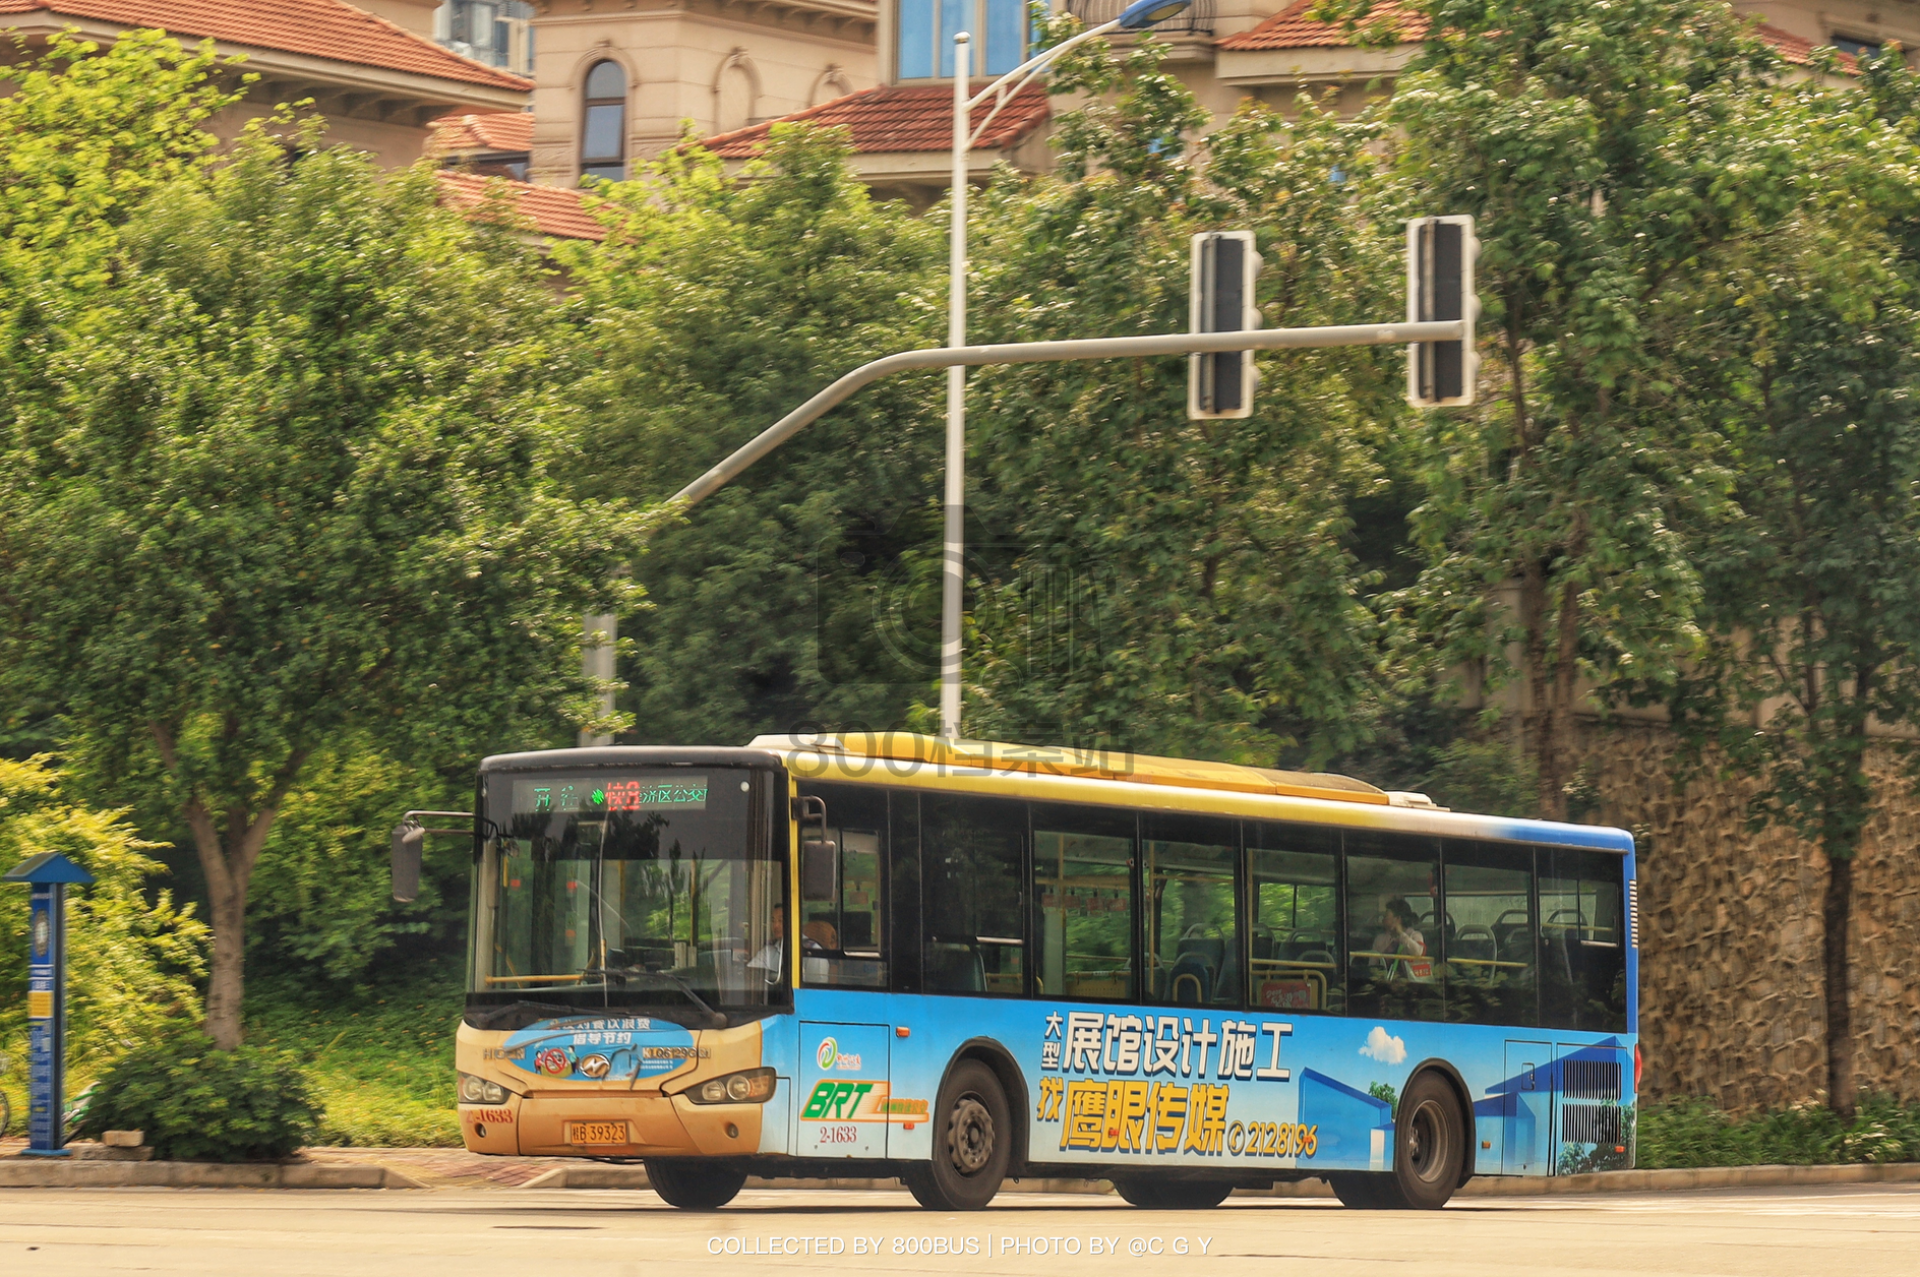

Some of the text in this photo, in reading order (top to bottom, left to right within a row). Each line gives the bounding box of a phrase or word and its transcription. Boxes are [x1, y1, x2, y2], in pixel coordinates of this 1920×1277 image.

[1062, 1011, 1293, 1081] 展馆设计施工
[802, 1082, 874, 1119] BRT
[819, 1126, 857, 1143] 2-1633
[1244, 1121, 1318, 1158] 2128196
